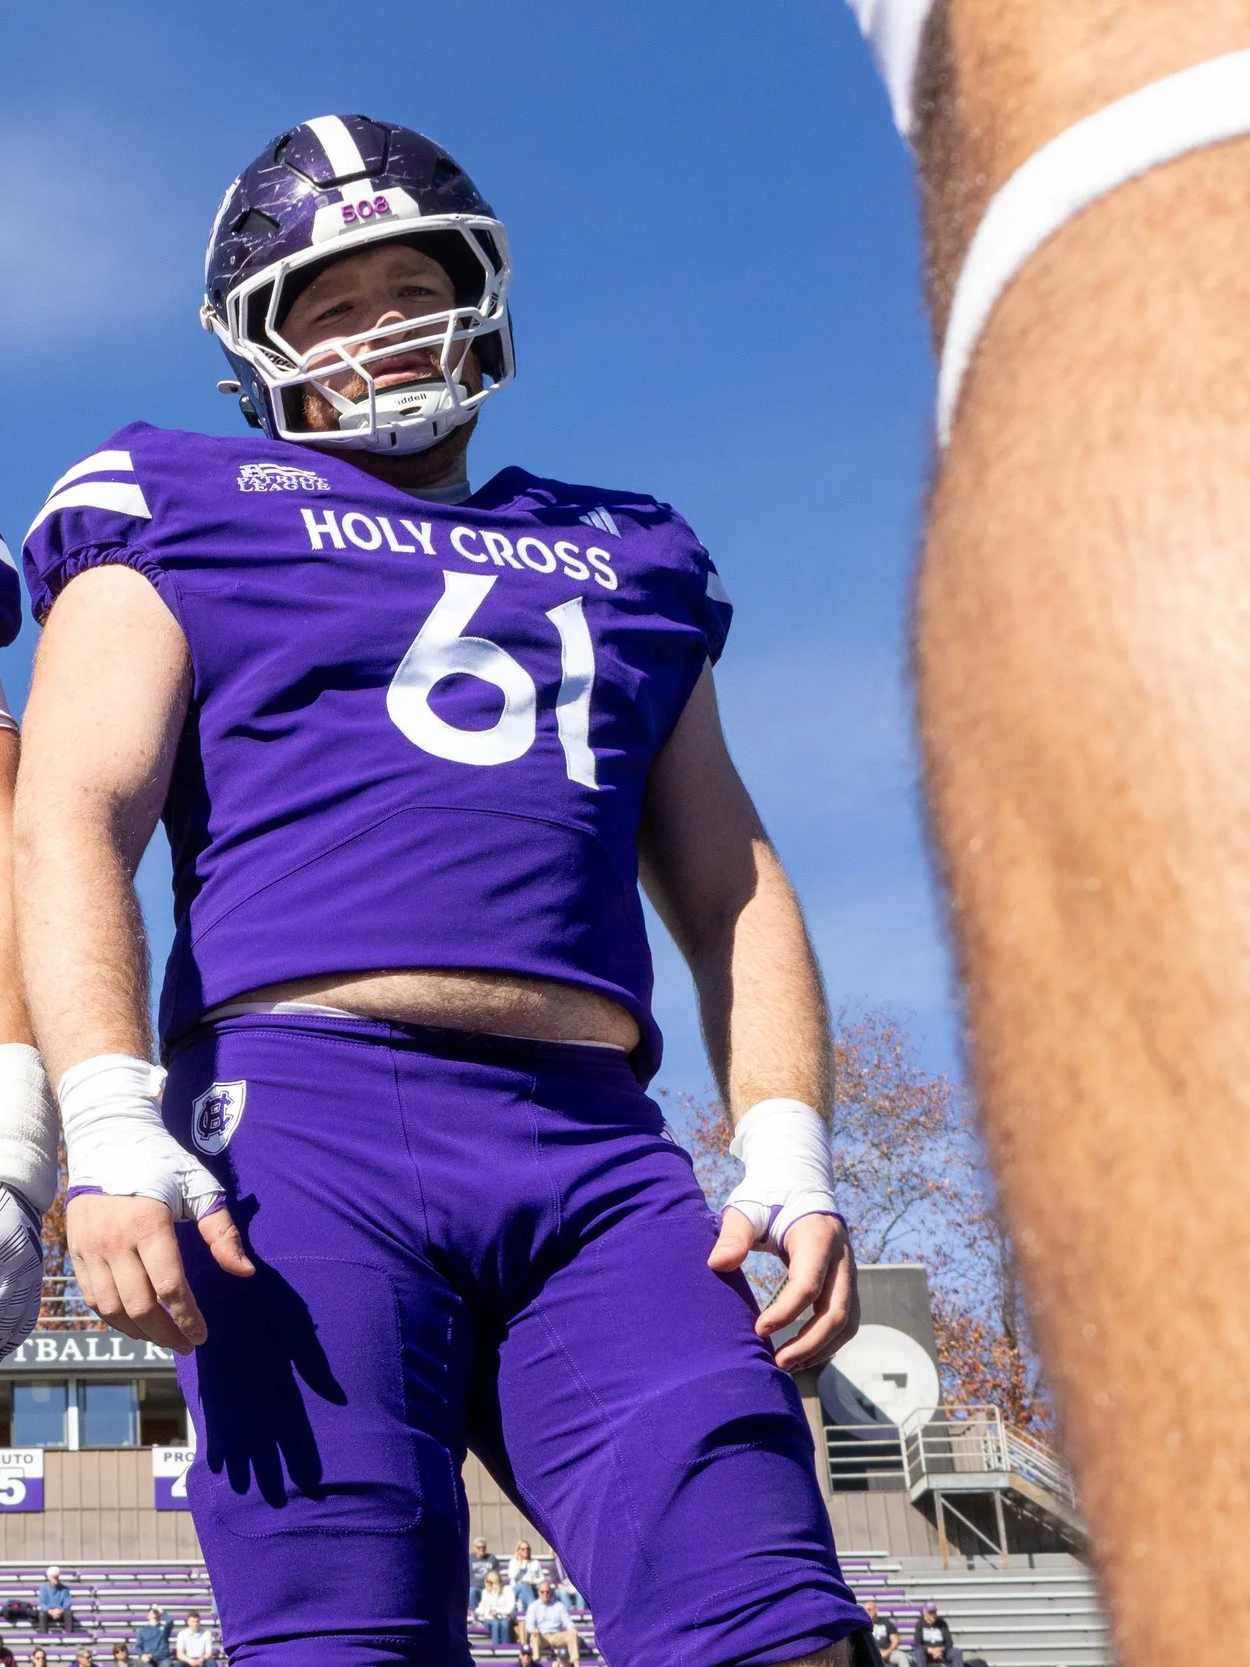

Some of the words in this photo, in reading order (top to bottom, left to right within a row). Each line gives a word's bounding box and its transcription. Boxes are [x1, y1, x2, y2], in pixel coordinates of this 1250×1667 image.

[342, 196, 390, 224] 508
[394, 393, 427, 405] iddell
[239, 480, 330, 492] LEAGUE
[301, 508, 437, 555] HOLY
[450, 527, 618, 591] CROSS
[386, 570, 600, 790] 61
[13, 1338, 135, 1362] TBALL
